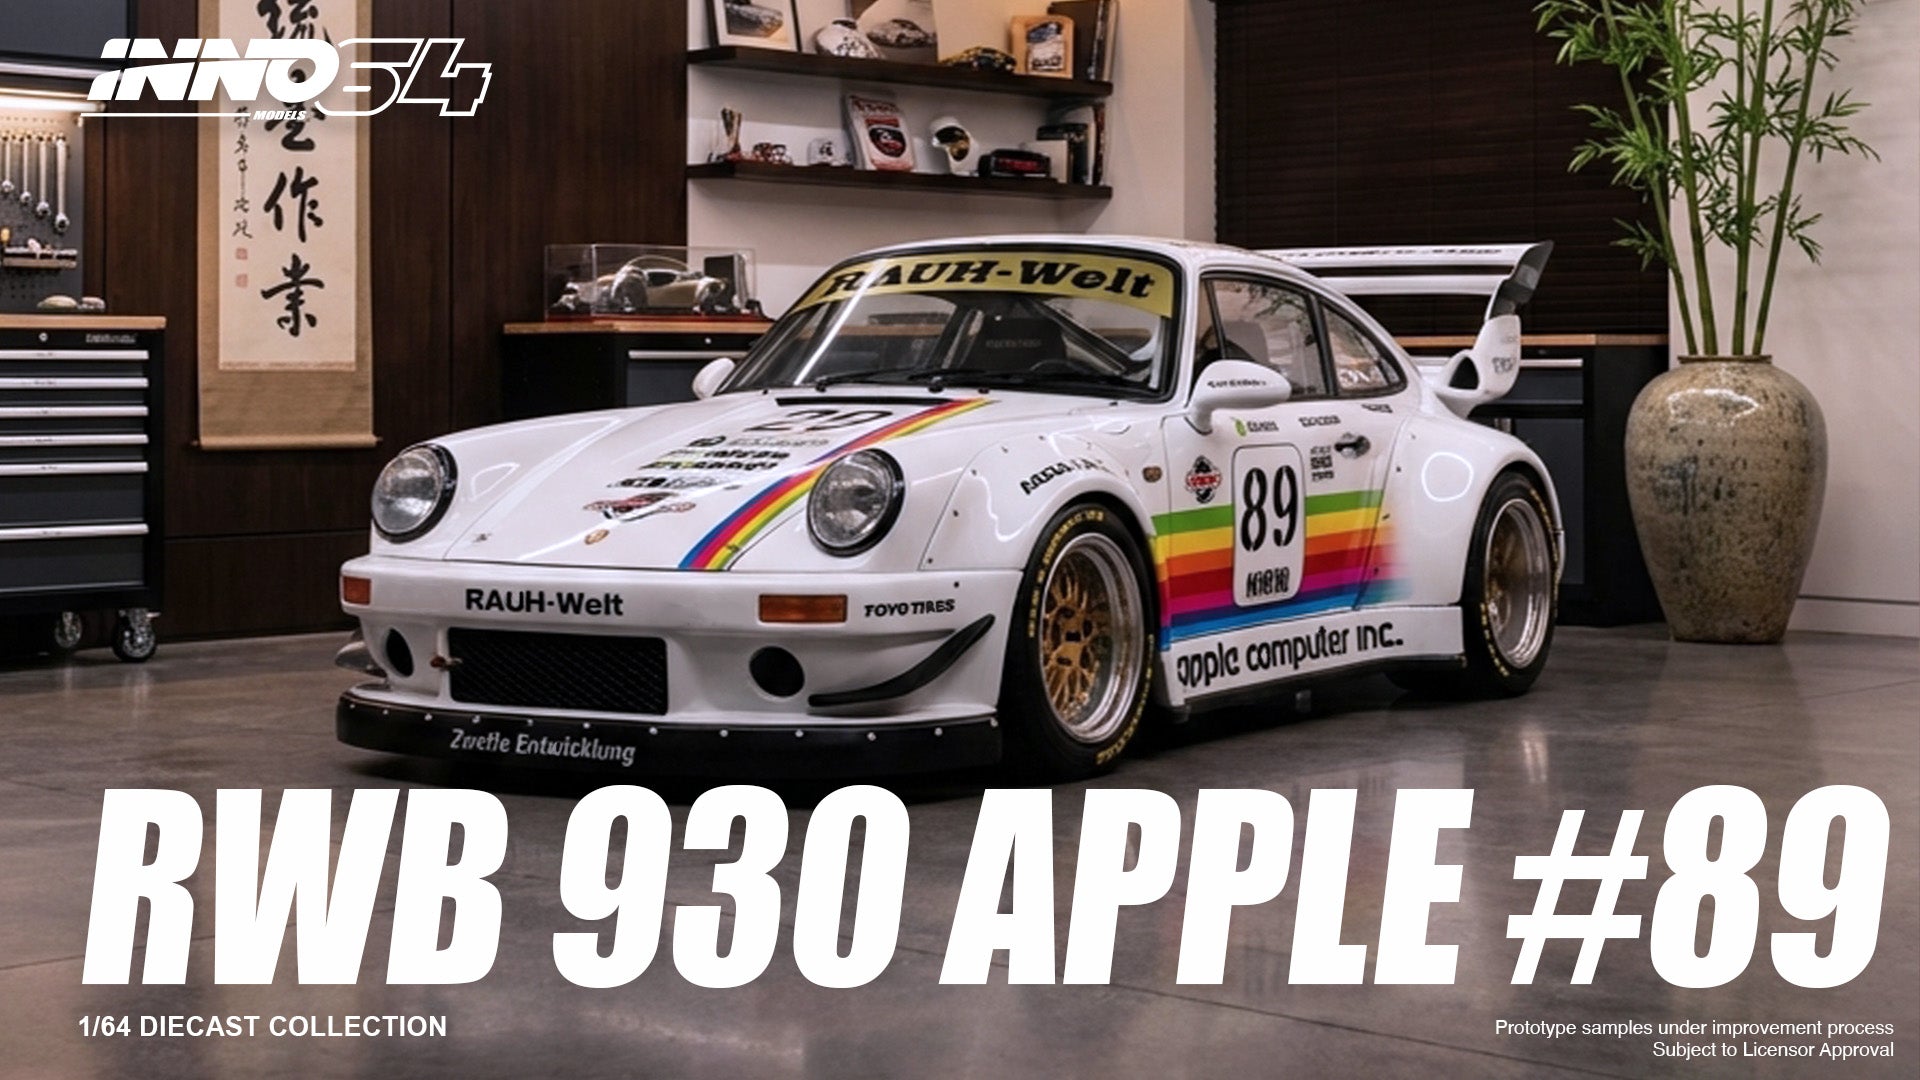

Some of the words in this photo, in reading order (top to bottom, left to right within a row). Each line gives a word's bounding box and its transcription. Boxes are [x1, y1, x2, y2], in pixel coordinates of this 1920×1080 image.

[825, 259, 1156, 300] RAUH-Welt
[1241, 465, 1298, 552] 89
[465, 588, 624, 616] RAUH-Welt
[864, 602, 909, 618] TOYO
[910, 598, 956, 614] TIRES
[1246, 625, 1350, 671] computer
[515, 733, 637, 768] Entwicklung
